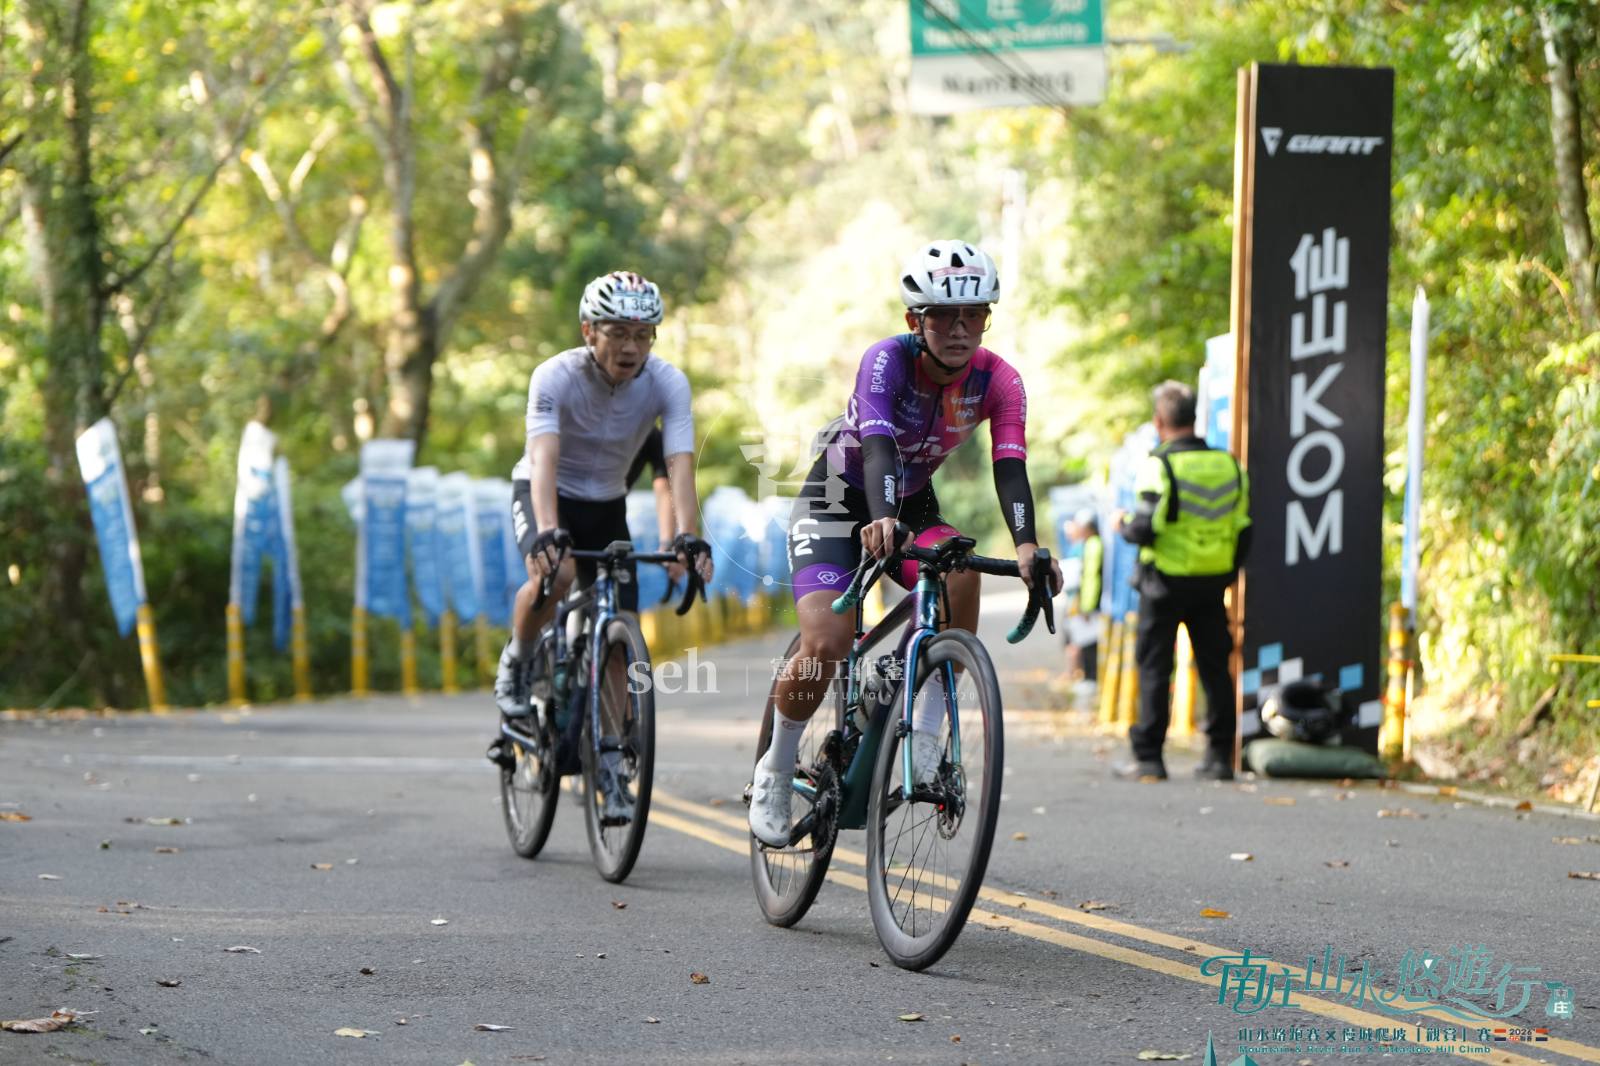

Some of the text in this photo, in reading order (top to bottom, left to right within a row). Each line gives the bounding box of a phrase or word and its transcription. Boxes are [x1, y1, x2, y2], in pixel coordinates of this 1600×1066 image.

[1286, 135, 1384, 155] GIANT
[941, 275, 981, 298] 177
[1013, 502, 1025, 532] VERGE
